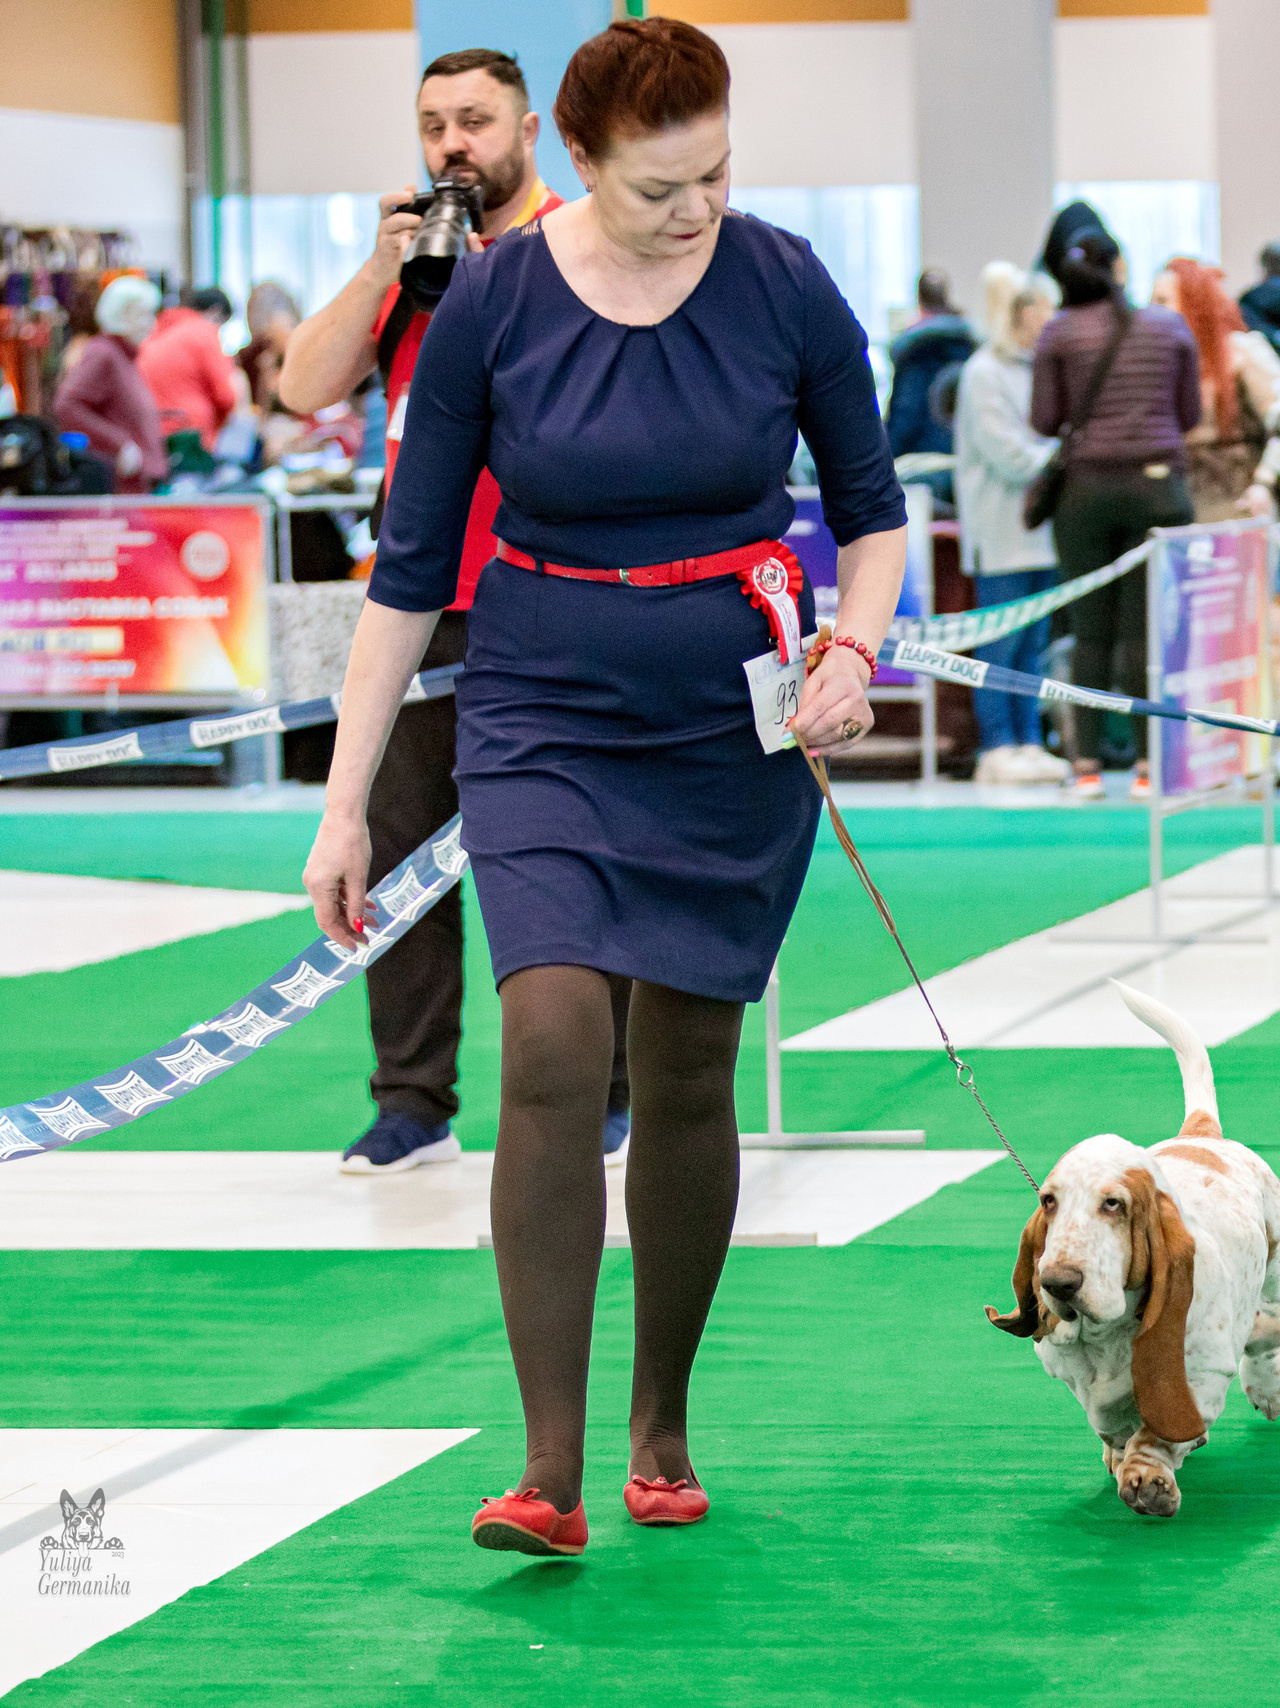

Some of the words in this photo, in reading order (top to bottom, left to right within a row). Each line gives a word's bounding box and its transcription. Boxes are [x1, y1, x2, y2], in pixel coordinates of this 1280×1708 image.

[899, 642, 949, 668] HAPPY
[950, 661, 982, 682] DOG
[165, 1057, 200, 1080] HAPPY
[191, 1047, 219, 1067] DOG
[104, 1087, 141, 1110] HAPPY
[128, 1079, 160, 1099] DOG
[40, 1112, 76, 1135] HAPPY
[66, 1105, 97, 1125] DOG
